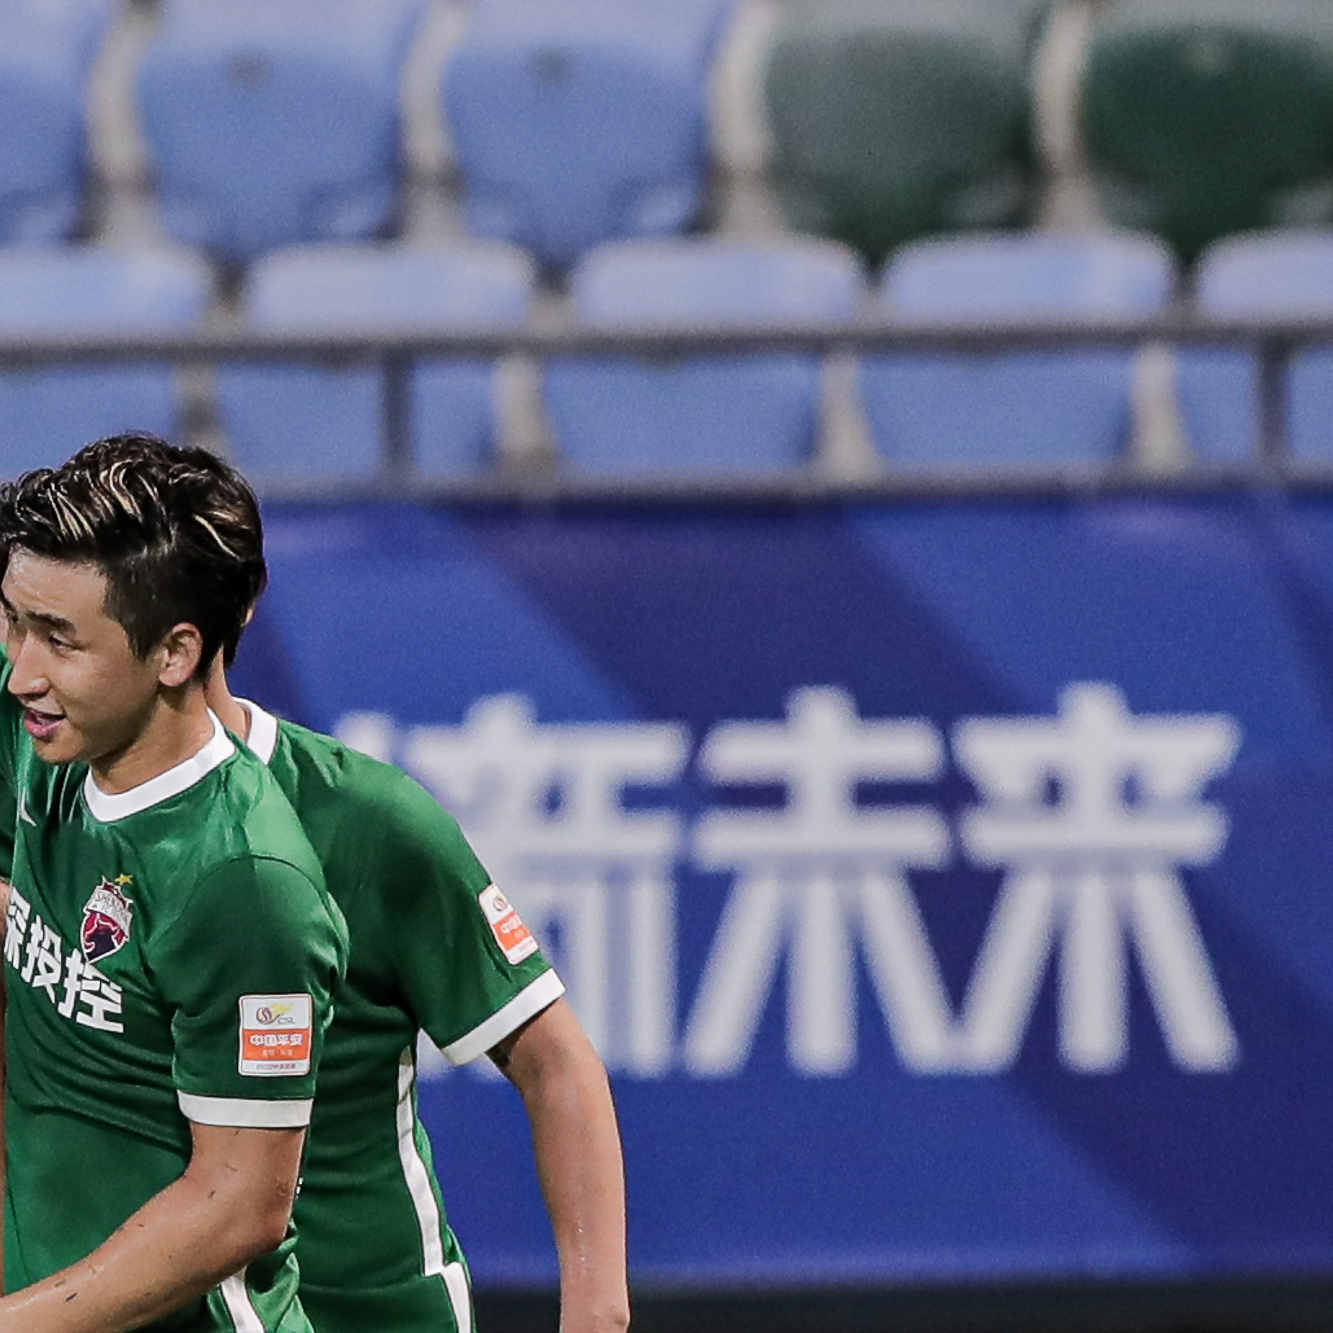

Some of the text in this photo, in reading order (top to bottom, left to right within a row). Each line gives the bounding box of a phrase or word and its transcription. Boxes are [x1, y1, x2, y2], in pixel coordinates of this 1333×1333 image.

[4, 886, 124, 1033] 深投控
[336, 680, 1240, 1078] 新未来
